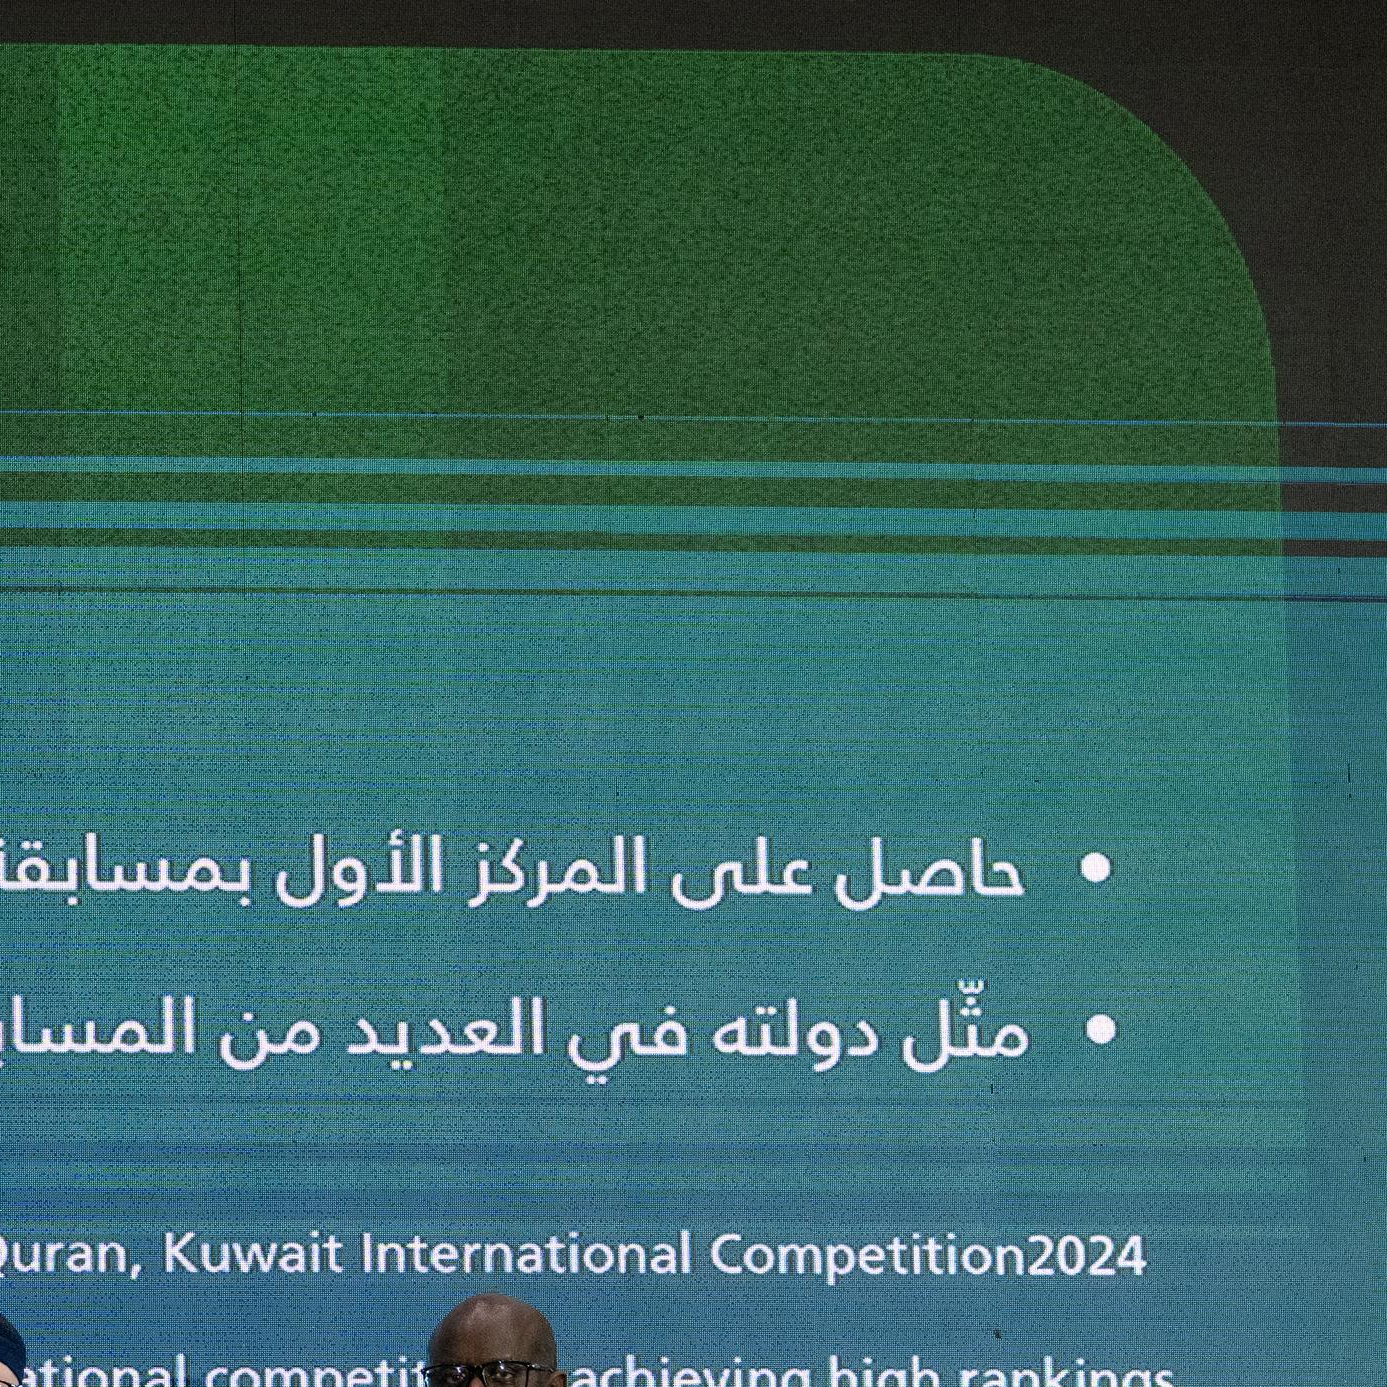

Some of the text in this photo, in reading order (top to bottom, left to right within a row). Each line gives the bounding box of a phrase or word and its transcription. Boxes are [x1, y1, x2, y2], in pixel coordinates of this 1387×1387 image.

[275, 829, 443, 909] الأول
[468, 835, 646, 909] المركز
[670, 835, 813, 911] على
[834, 836, 1025, 912] حاصل
[219, 1010, 321, 1071] من
[347, 996, 544, 1070] العديد
[567, 1004, 688, 1085] في
[712, 997, 879, 1073] دولته
[164, 1230, 342, 1274] Kuwait
[362, 1230, 691, 1275] International
[710, 1232, 1147, 1286] Competition2024
